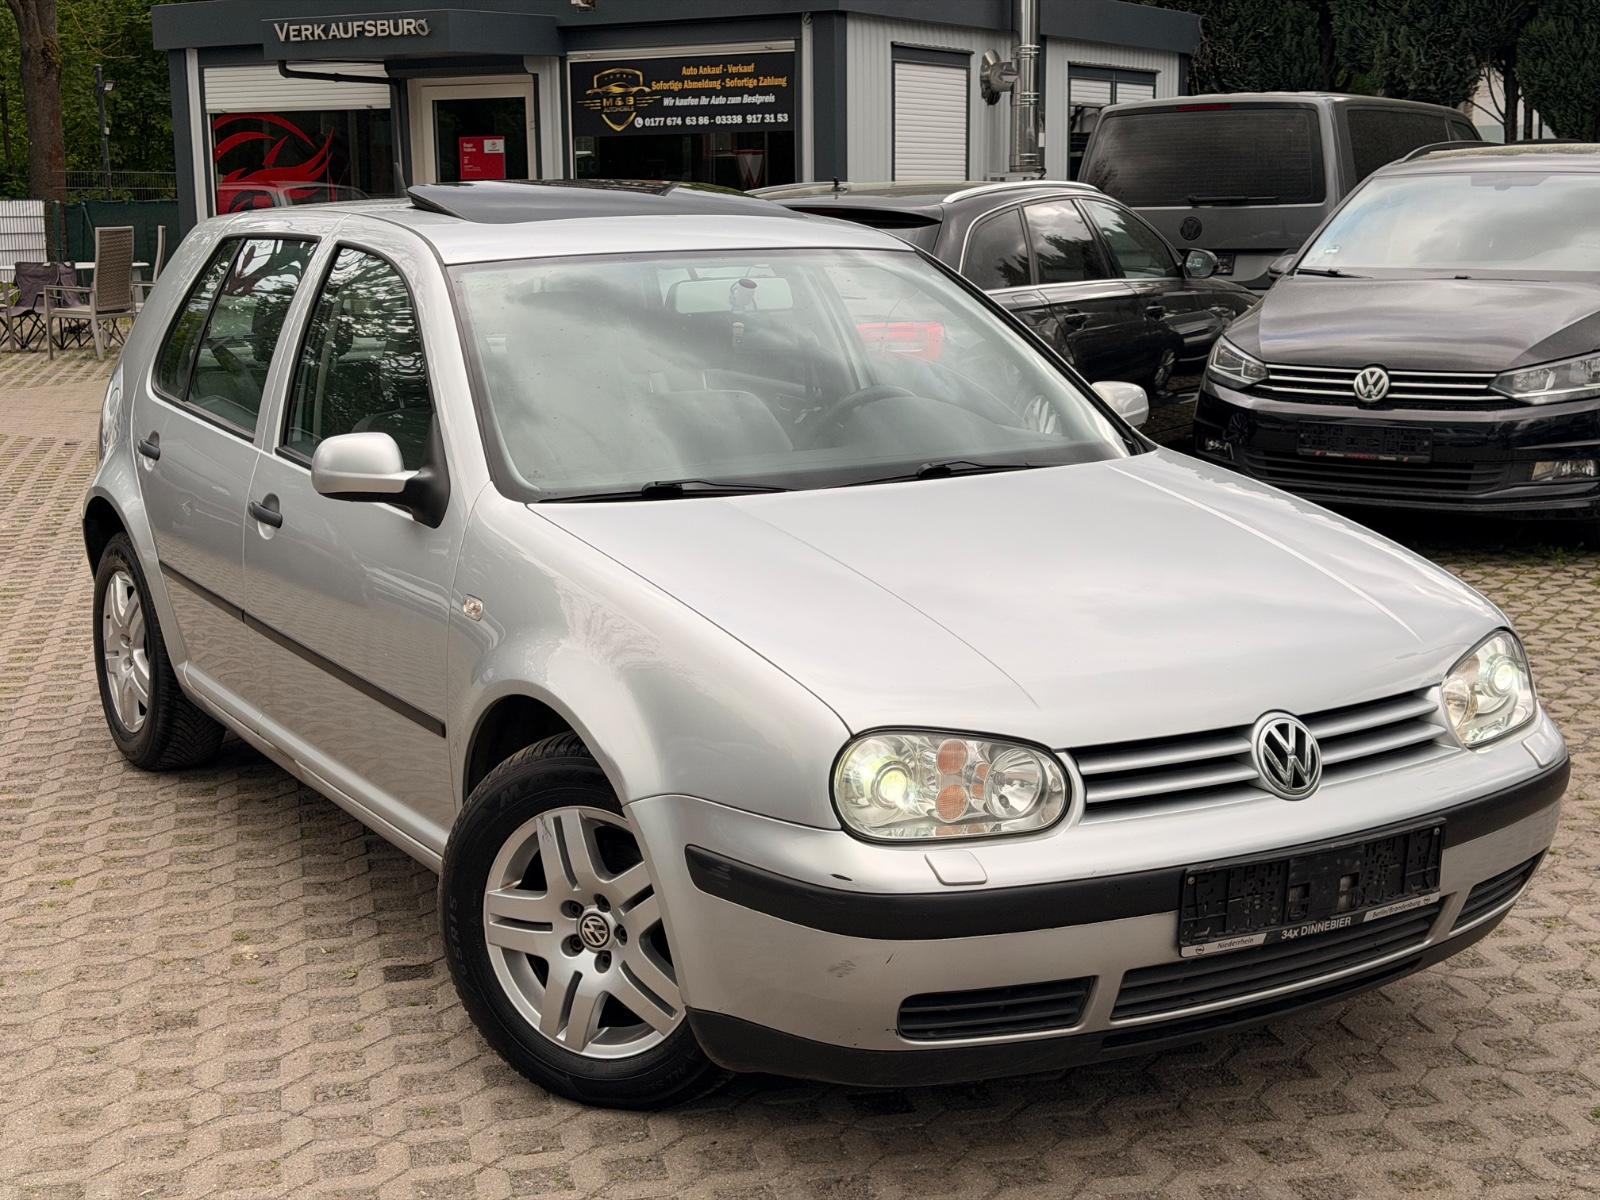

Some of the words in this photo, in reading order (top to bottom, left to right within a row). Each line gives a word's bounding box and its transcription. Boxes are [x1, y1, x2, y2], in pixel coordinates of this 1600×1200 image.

[681, 66, 698, 76] Auto
[699, 64, 723, 75] Ankauf
[727, 63, 755, 73] Verkauf
[651, 80, 683, 92] Sofortige
[683, 79, 721, 90] Abmeldung
[725, 77, 758, 89] Sofortige
[758, 76, 788, 88] Zahlung
[602, 98, 613, 106] M
[663, 97, 675, 107] Wir
[675, 96, 699, 106] kaufen
[700, 95, 710, 105] Ihr
[710, 95, 727, 105] Auto
[727, 96, 742, 104] zum
[742, 93, 776, 105] Bestpreis
[644, 117, 665, 127] 0177
[666, 116, 683, 126] 674
[685, 116, 697, 126] 63
[715, 114, 743, 125] 03338
[746, 113, 763, 124] 917
[764, 113, 776, 123] 31
[777, 113, 789, 122] 53
[1354, 367, 1389, 401] VW
[1252, 711, 1322, 800] VW
[582, 915, 609, 946] VW
[1300, 916, 1352, 936] DINNEBIER
